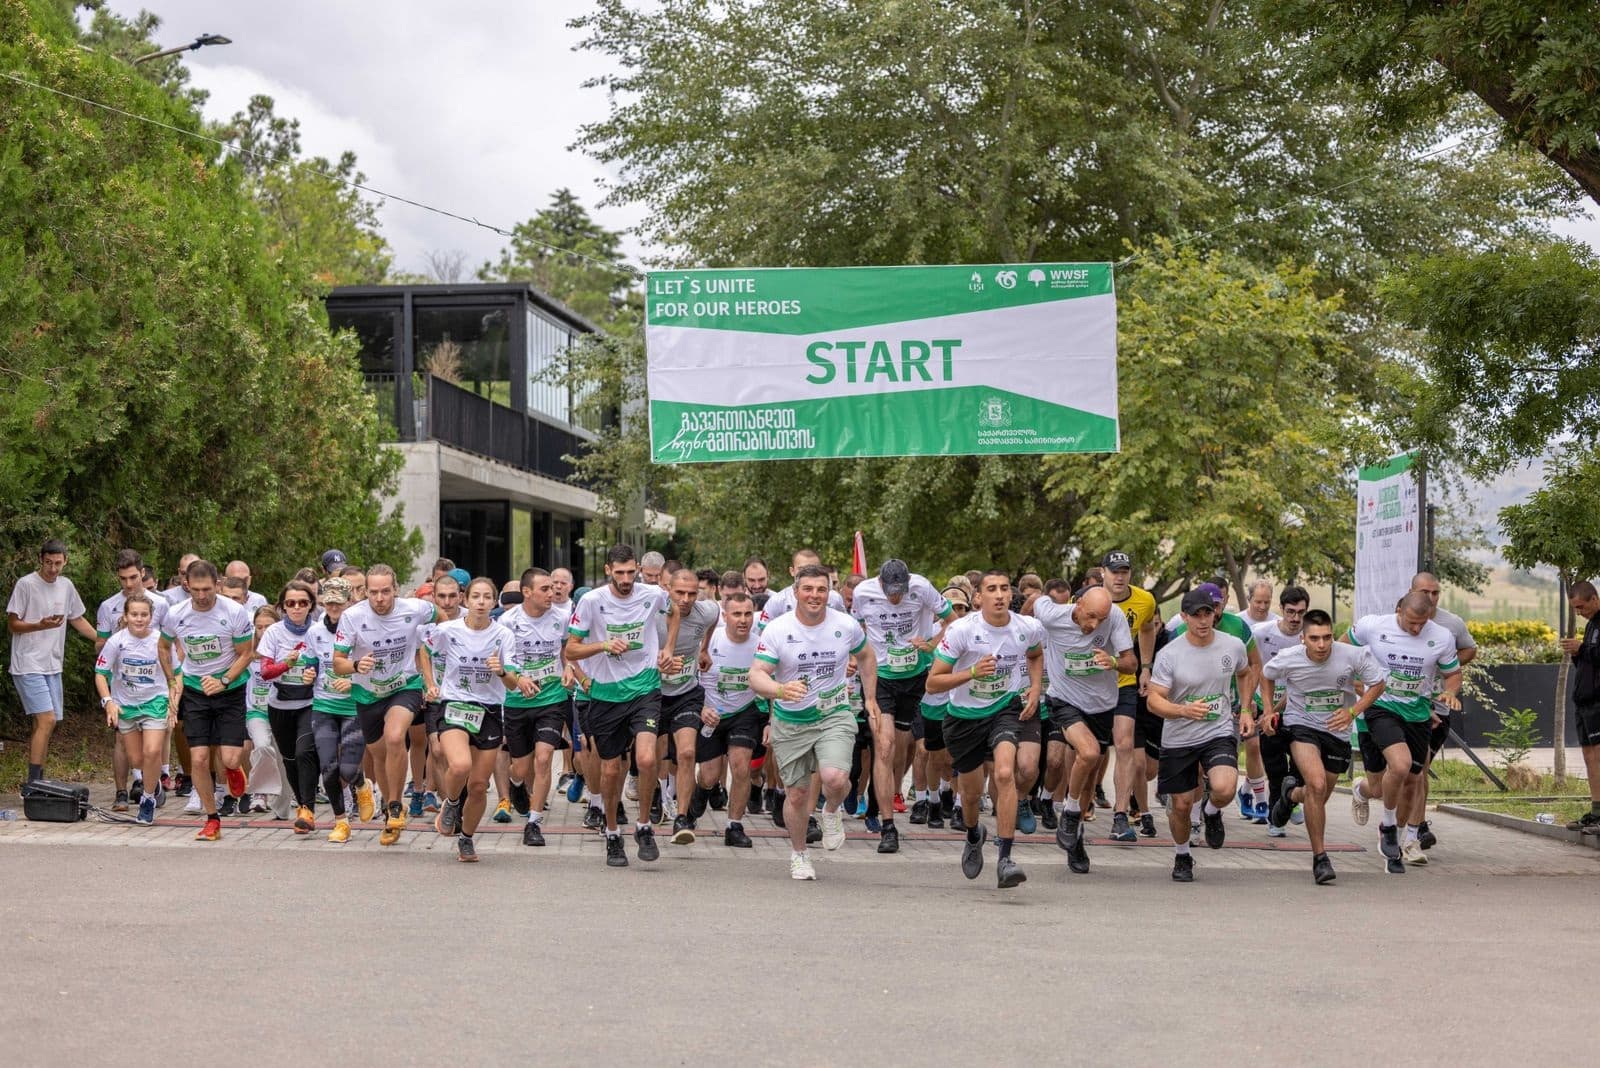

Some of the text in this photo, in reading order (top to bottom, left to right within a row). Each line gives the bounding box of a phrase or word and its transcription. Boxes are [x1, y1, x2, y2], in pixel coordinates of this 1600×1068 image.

[1050, 269, 1089, 280] WWSF
[705, 278, 756, 294] UNITE
[655, 300, 801, 317] FOR OUR HEROES
[806, 339, 962, 385] START
[682, 408, 796, 432] გავერთიანდეთ
[707, 429, 816, 452] გმირებისთვის
[626, 631, 641, 641] 127
[202, 643, 216, 652] 176
[904, 654, 916, 664] 152
[138, 667, 153, 675] 306
[543, 666, 555, 675] 112
[990, 680, 1005, 691] 153
[464, 712, 479, 722] 181
